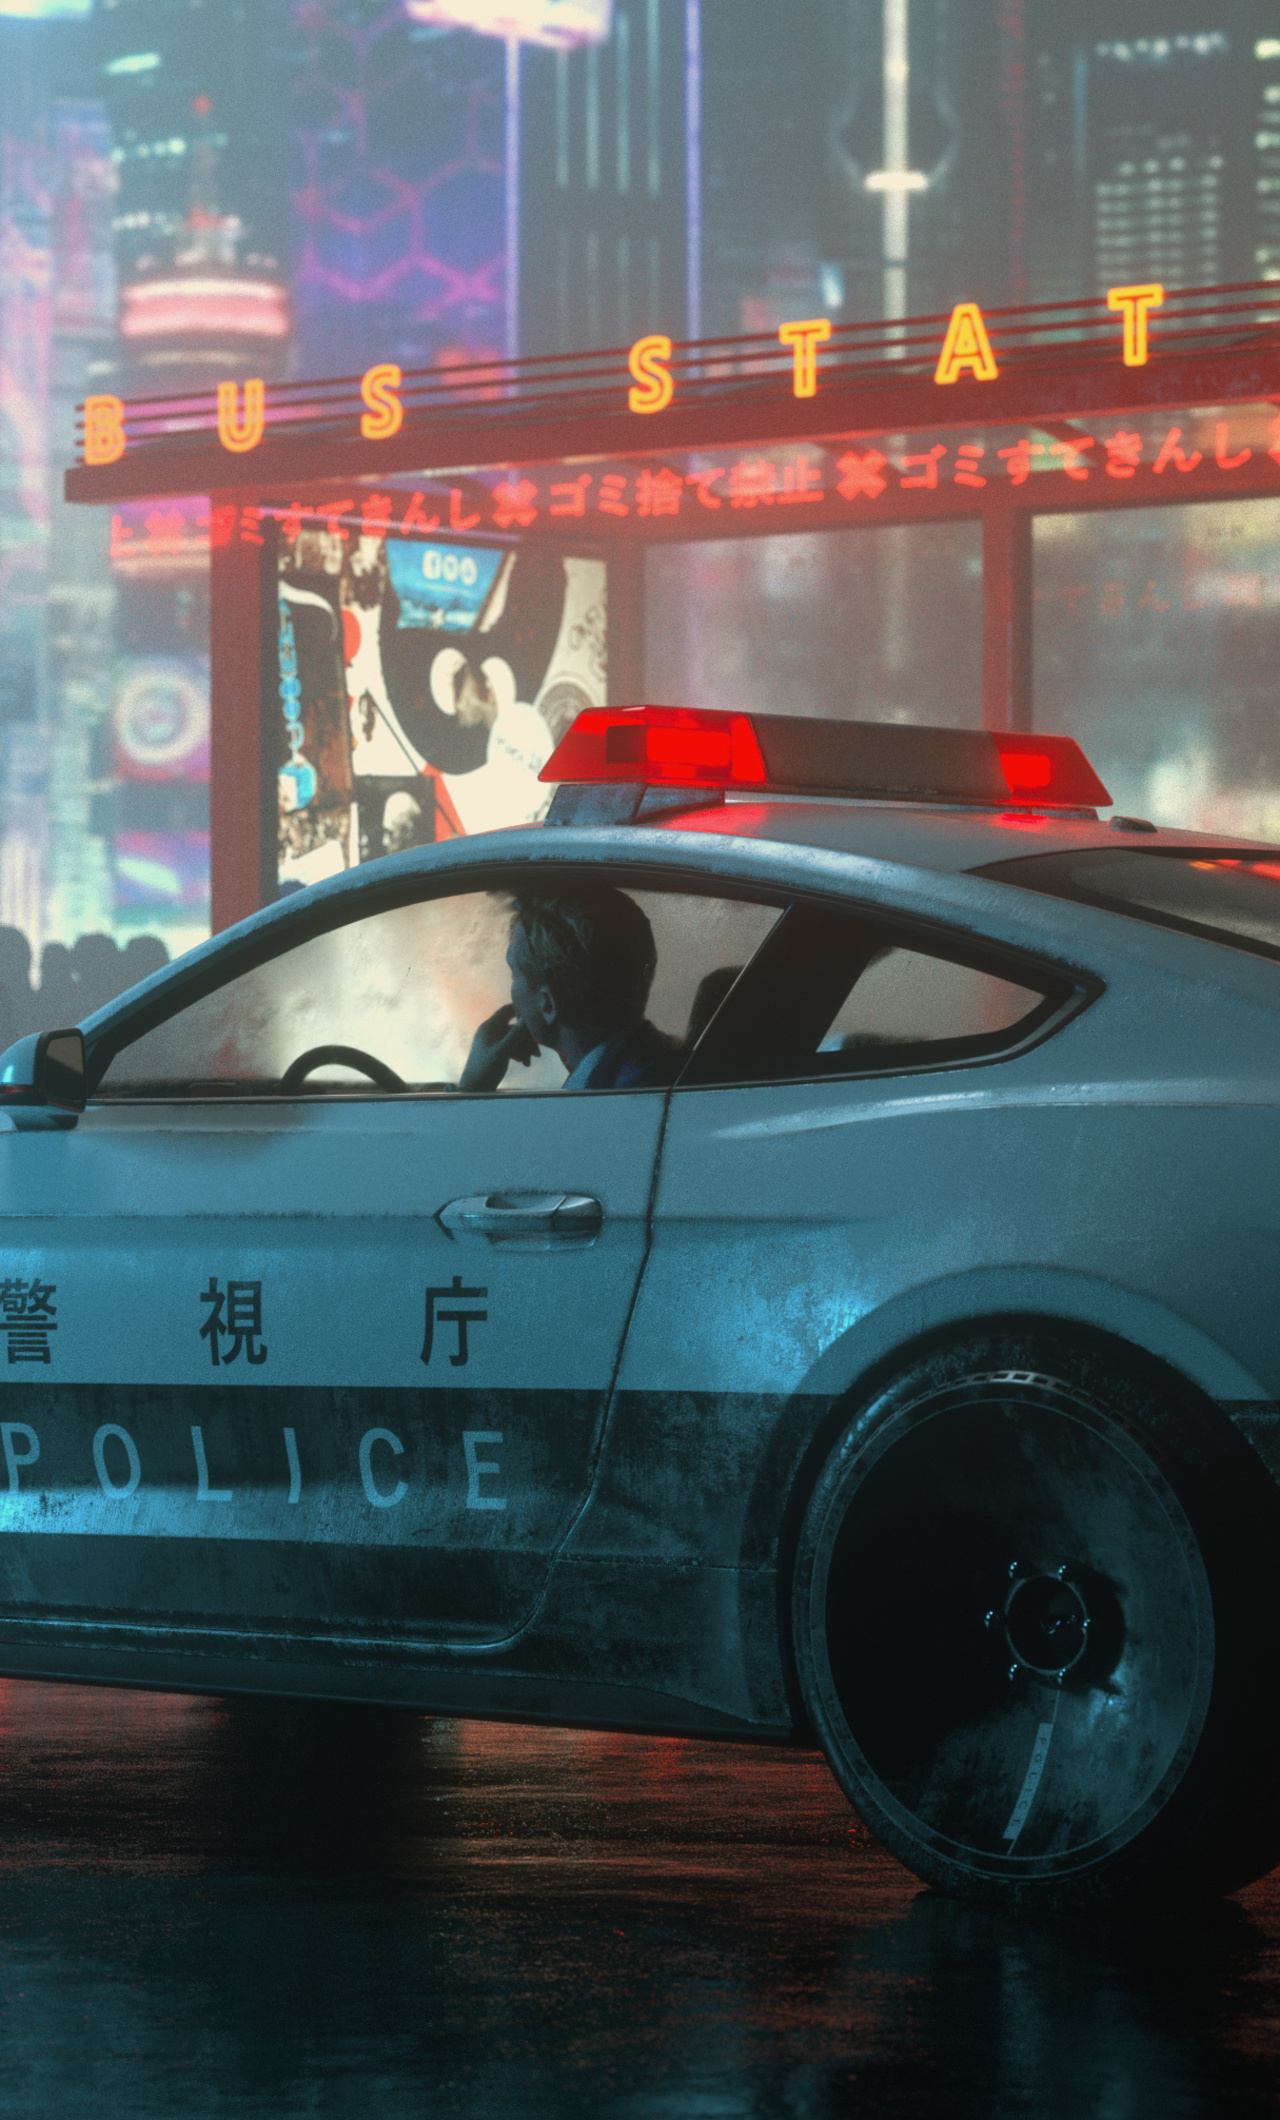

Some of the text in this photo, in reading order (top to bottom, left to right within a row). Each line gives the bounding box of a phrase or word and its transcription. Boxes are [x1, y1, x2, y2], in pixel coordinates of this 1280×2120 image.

[84, 283, 1164, 465] BUS STAT
[0, 1276, 488, 1367] 警視庁
[0, 1422, 507, 1511] POLICE
[1011, 1736, 1047, 1827] POLICE
